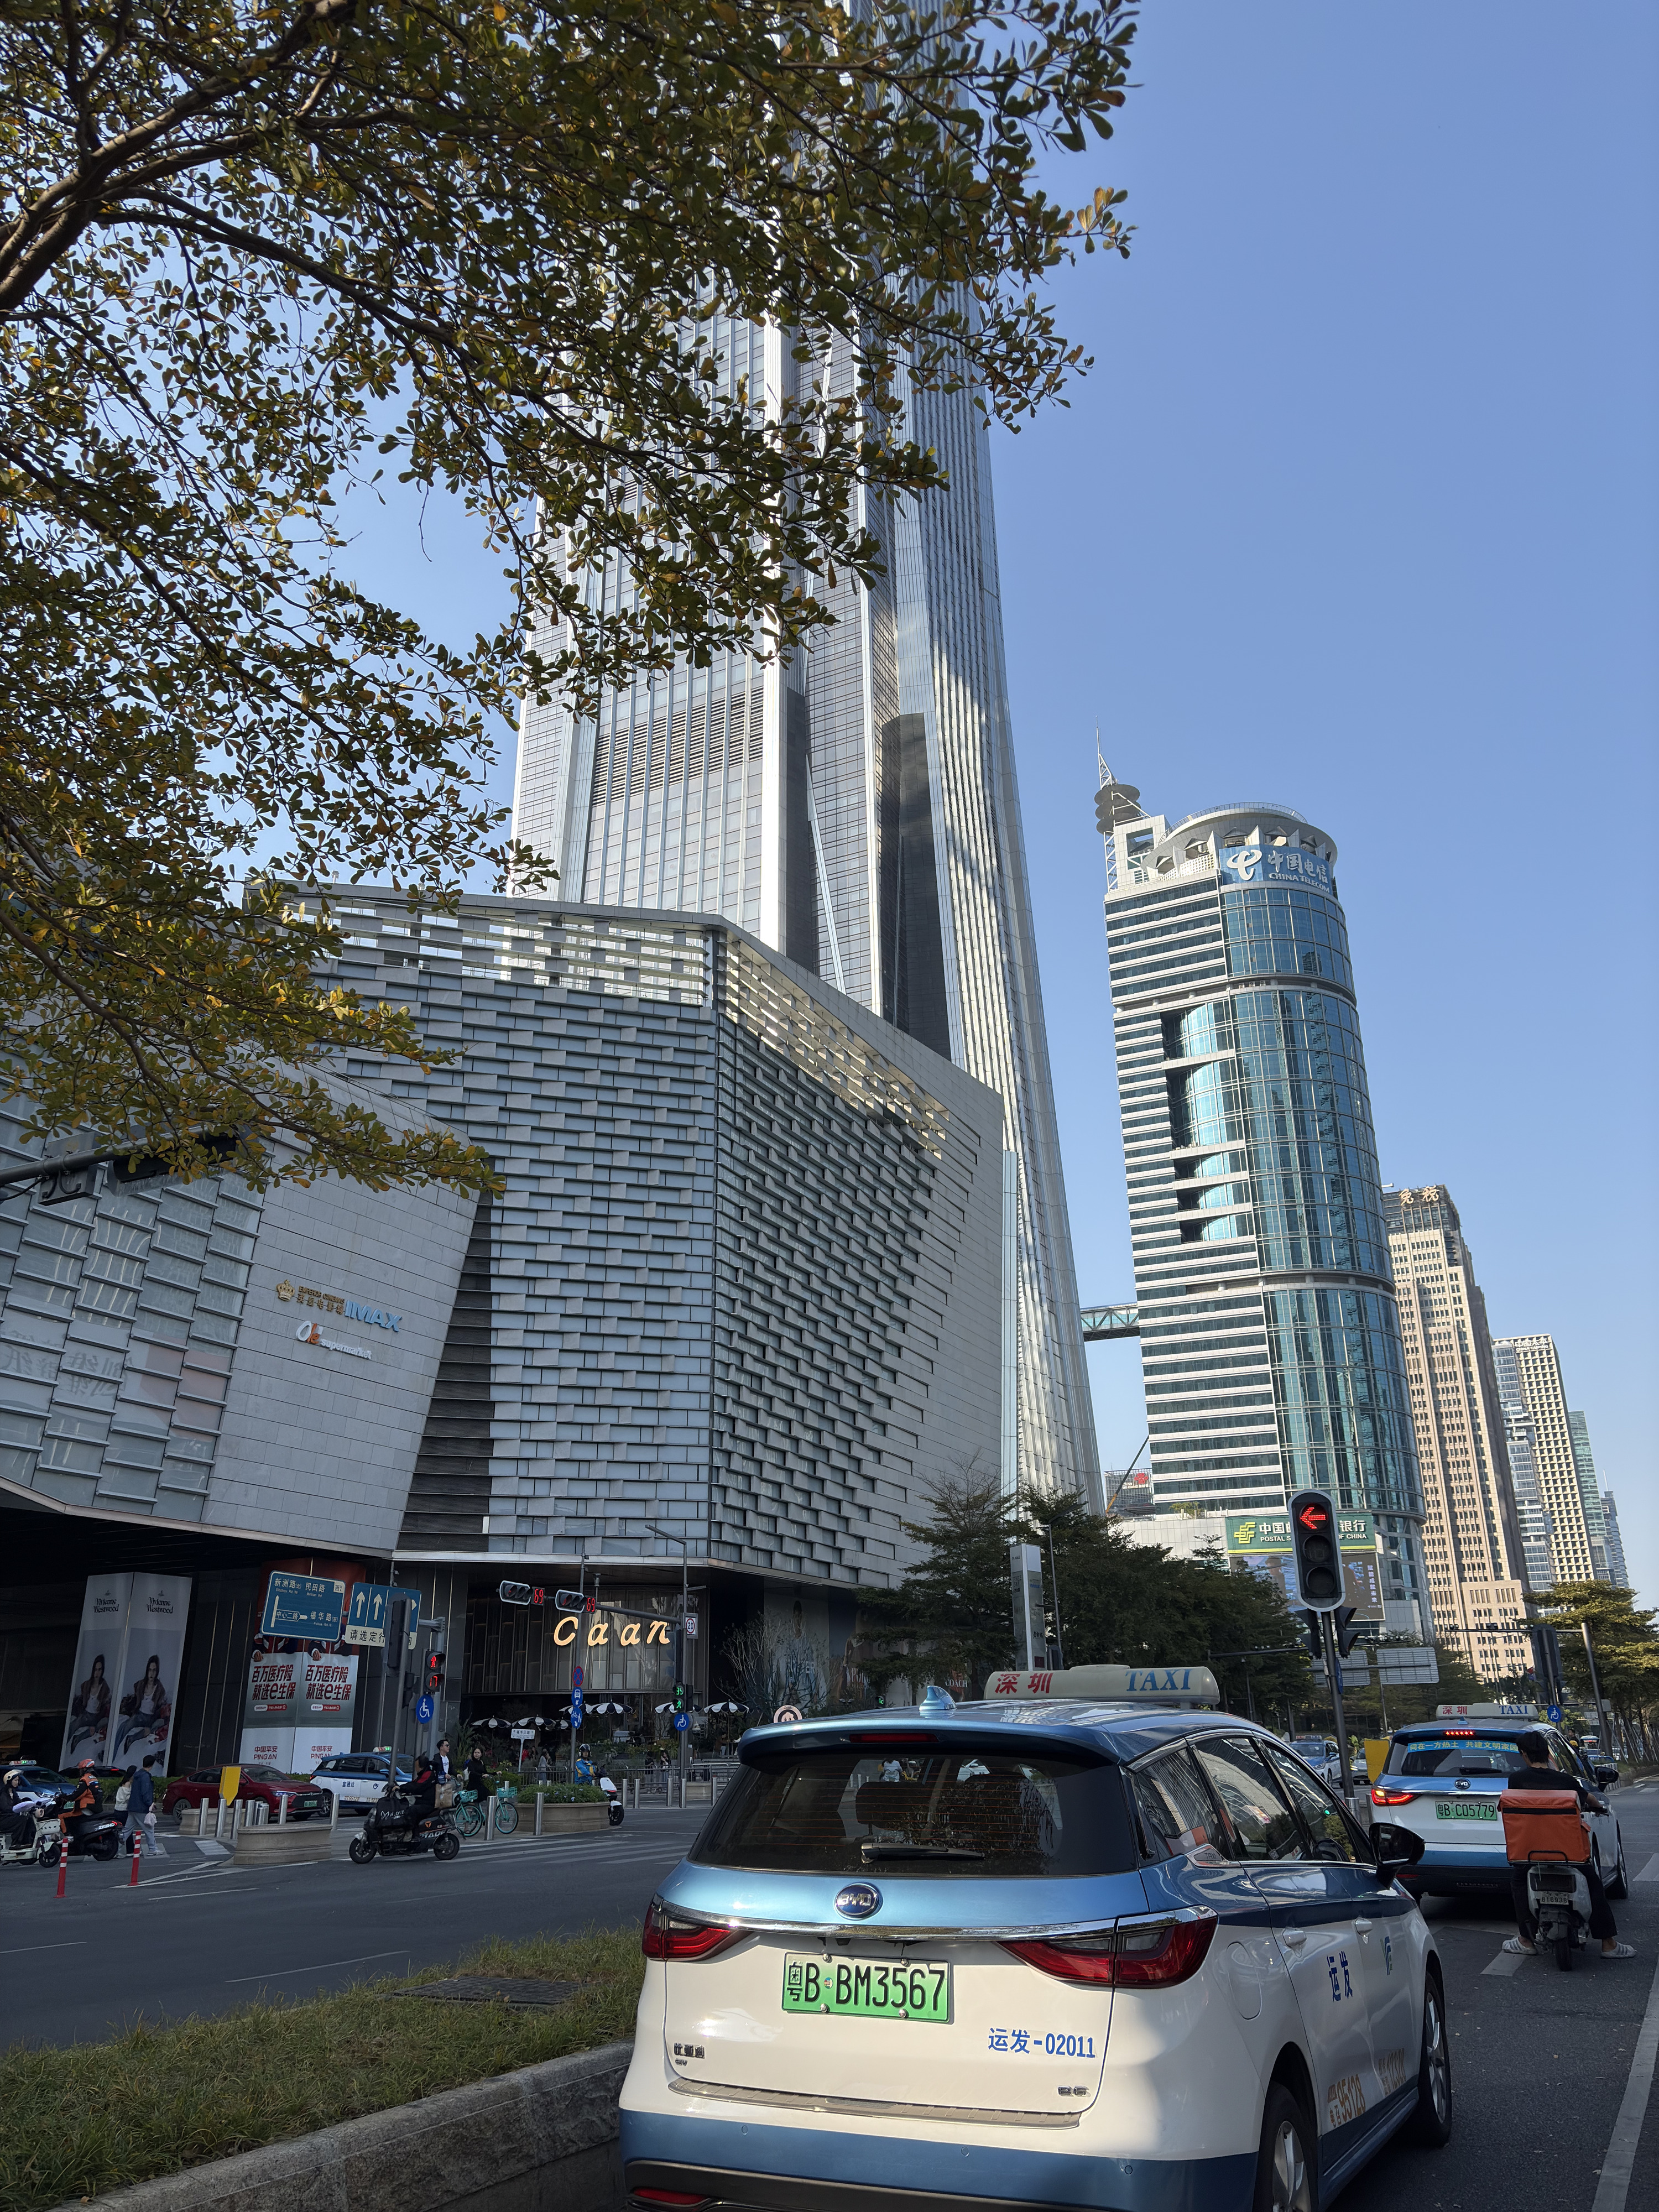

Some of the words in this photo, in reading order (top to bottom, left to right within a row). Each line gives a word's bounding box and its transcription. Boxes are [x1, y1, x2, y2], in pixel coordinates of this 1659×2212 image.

[1267, 850, 1328, 883] 中国电信
[1269, 873, 1299, 881] CHINA
[1299, 875, 1330, 893] TELECOM
[299, 1286, 322, 1297] EMPEROR
[322, 1293, 345, 1305] CINEMAS
[345, 1300, 403, 1332] IMAX
[320, 1338, 372, 1359] supermarket
[305, 1582, 325, 1593] 民田路
[534, 1588, 544, 1604] 69
[93, 1604, 119, 1614] Westwood
[146, 1604, 174, 1614] Westwood
[149, 1597, 171, 1606] Vivienne
[586, 1597, 596, 1612] 69
[276, 1611, 298, 1620] 中心二路
[554, 1616, 670, 1646] Caan
[252, 1665, 294, 1683] 百万医疗险
[305, 1665, 349, 1683] 百万医疗险
[430, 1676, 438, 1687] 17
[1125, 1668, 1192, 1692] TAXI
[252, 1682, 296, 1700] 就选e生保
[306, 1683, 352, 1700] 就选e生保
[676, 1687, 684, 1695] 35
[945, 1679, 968, 1688] COACH
[995, 1673, 1053, 1694] 深圳
[1442, 1706, 1467, 1715] 深圳
[1499, 1705, 1528, 1714] TAXI
[1410, 1741, 1459, 1751] 同在一方热土
[1465, 1741, 1519, 1751] 共建文明家园
[837, 1892, 872, 1906] BYD
[1326, 1950, 1353, 2003] 运发
[988, 2027, 1095, 2058] 运发-02011
[1337, 2073, 1366, 2122] 95128
